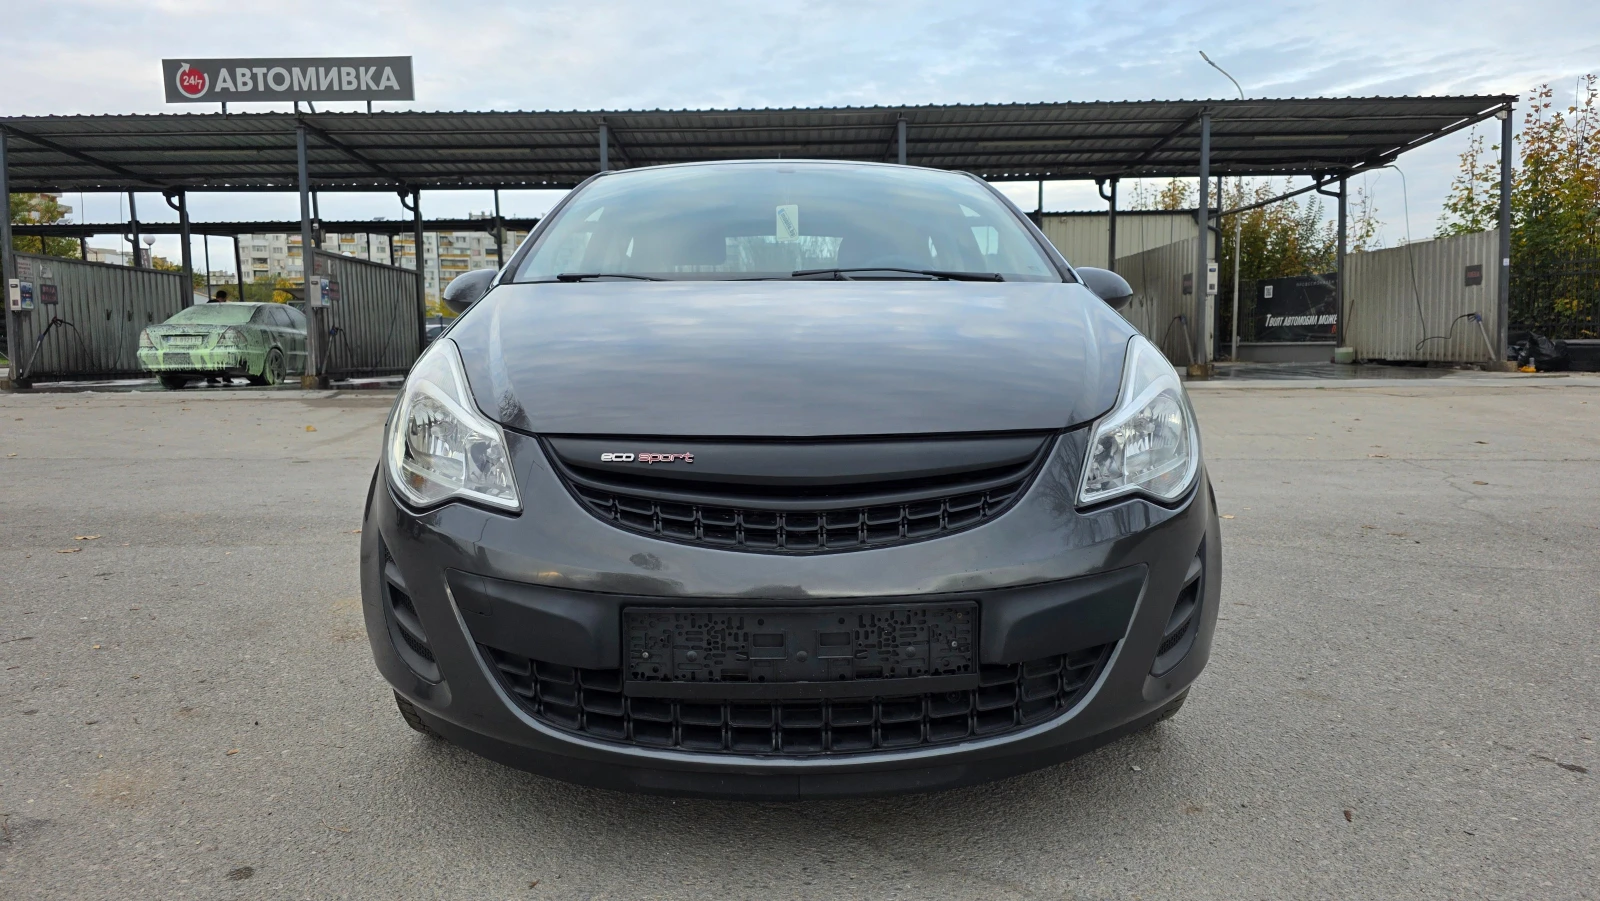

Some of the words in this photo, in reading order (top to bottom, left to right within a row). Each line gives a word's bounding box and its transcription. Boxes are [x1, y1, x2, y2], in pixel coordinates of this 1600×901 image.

[183, 75, 203, 90] 24/7
[214, 66, 400, 92] АВТОМИВКА
[600, 452, 635, 462] eco
[638, 452, 694, 464] sport
